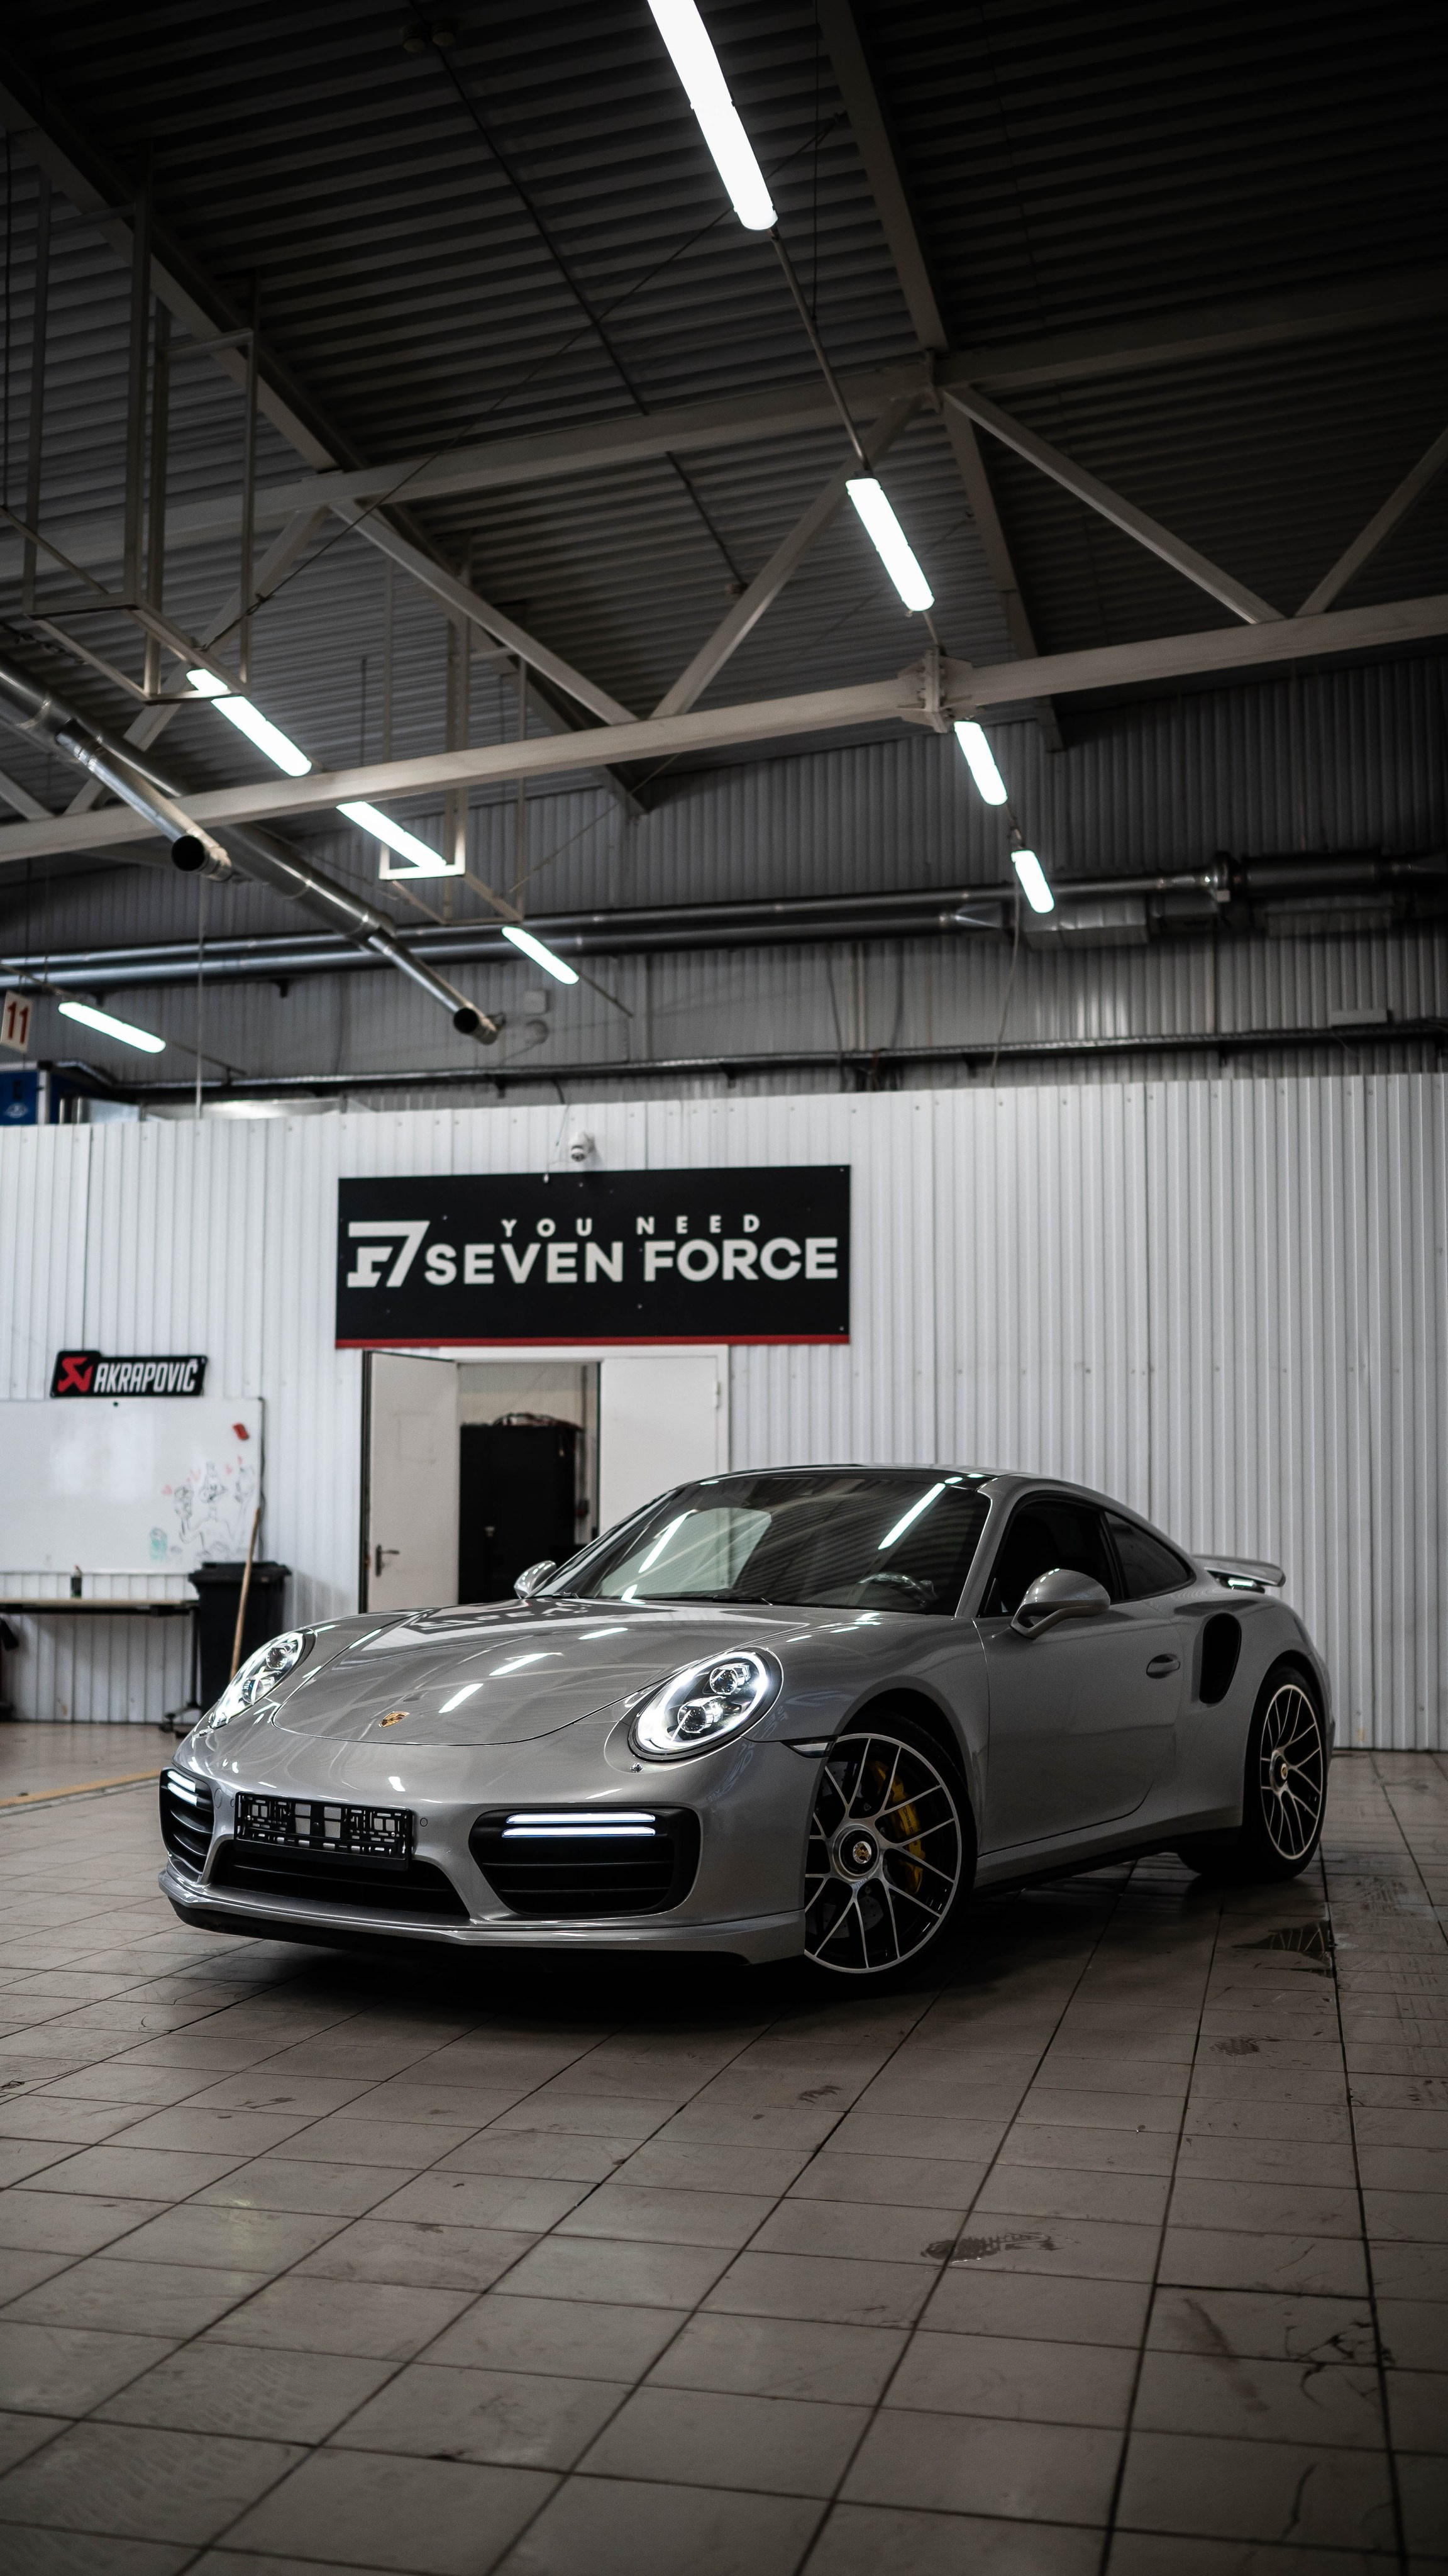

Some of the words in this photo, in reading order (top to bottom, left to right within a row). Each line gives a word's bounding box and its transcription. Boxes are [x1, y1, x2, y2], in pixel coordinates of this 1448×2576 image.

[7, 1001, 29, 1045] 11
[501, 1218, 592, 1238] YOU
[636, 1214, 760, 1235] NEED
[424, 1241, 623, 1285] SEVEN
[644, 1237, 838, 1282] FORCE
